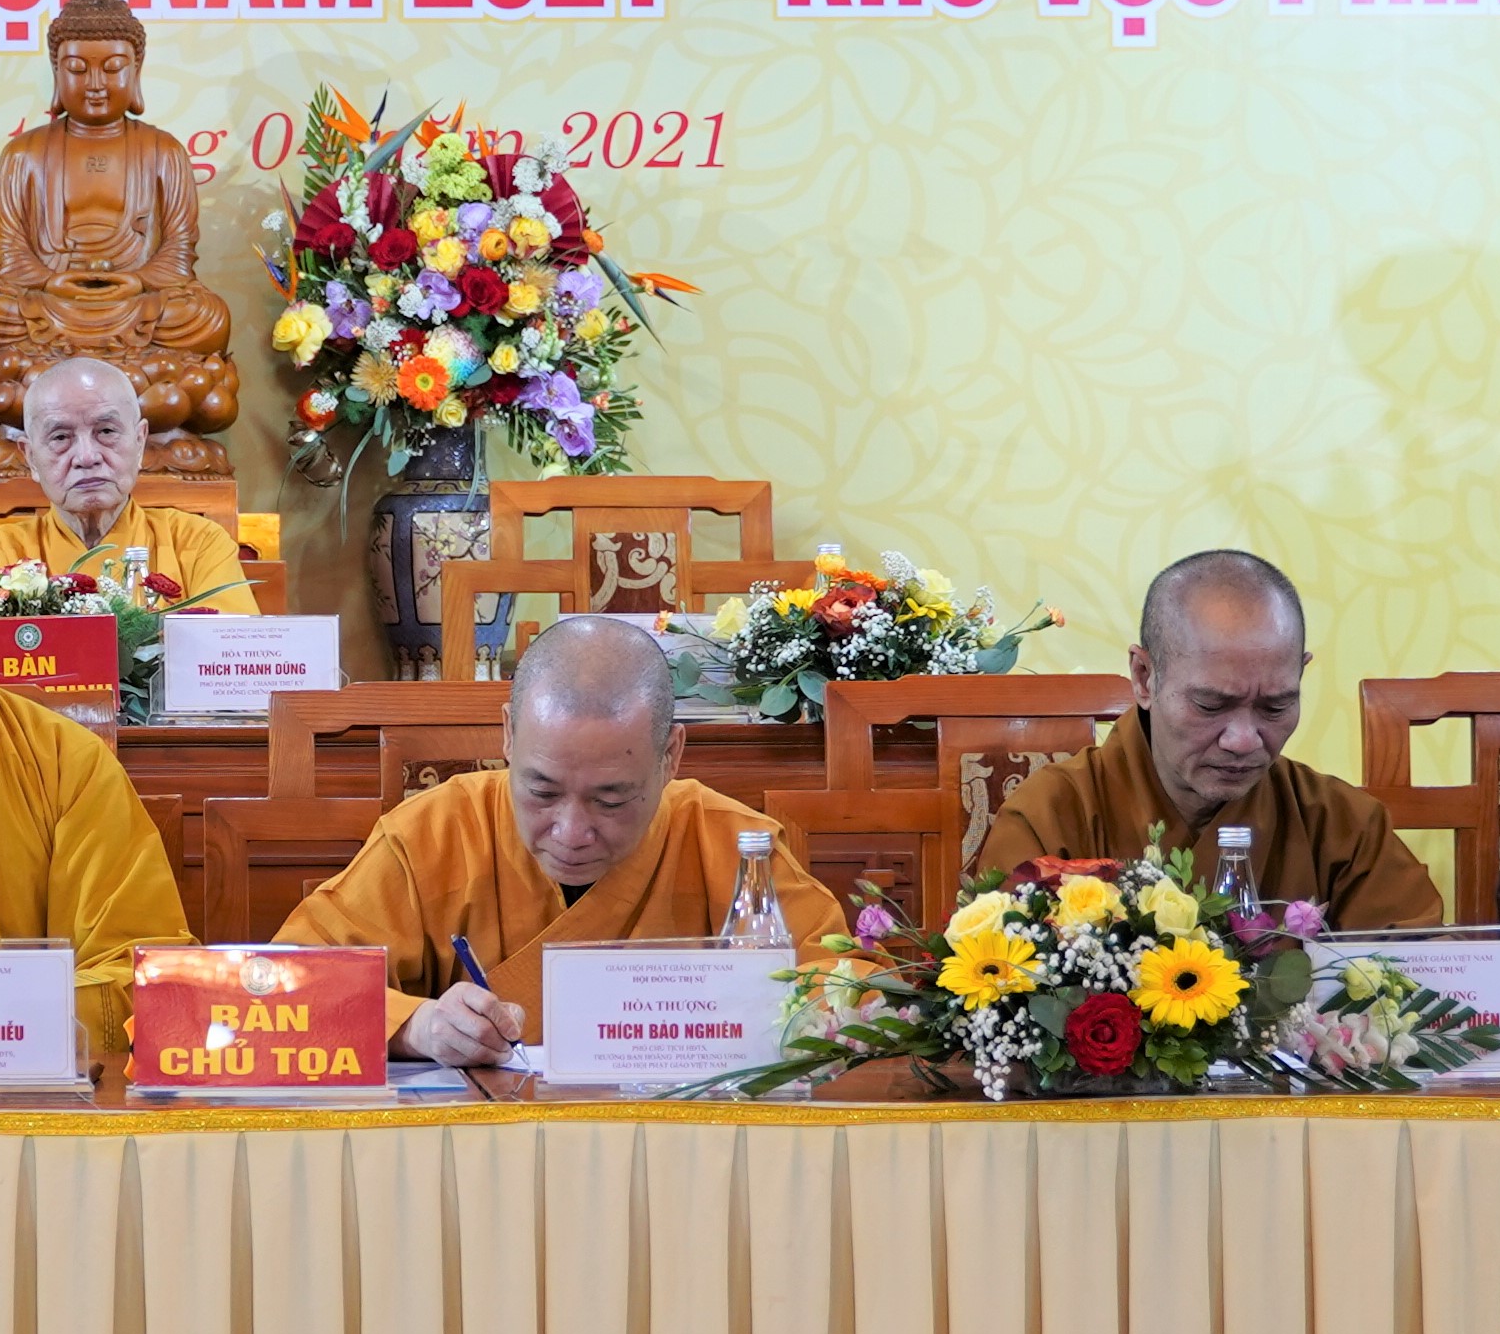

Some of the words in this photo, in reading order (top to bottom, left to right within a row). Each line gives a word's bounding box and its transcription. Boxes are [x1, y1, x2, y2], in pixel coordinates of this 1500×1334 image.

[561, 111, 726, 169] 2021
[3, 653, 56, 677] BÀN
[198, 661, 231, 676] THÍCH
[234, 664, 271, 676] THANH
[211, 999, 309, 1032] BÀN
[623, 999, 653, 1011] HÒA
[656, 1000, 717, 1014] THƯỢNG
[597, 1021, 643, 1039] THÍCH
[649, 1019, 679, 1039] BẢO
[684, 1020, 743, 1039] NGHIÊM
[160, 1038, 254, 1075] CHỦ
[271, 1047, 362, 1081] TỌA
